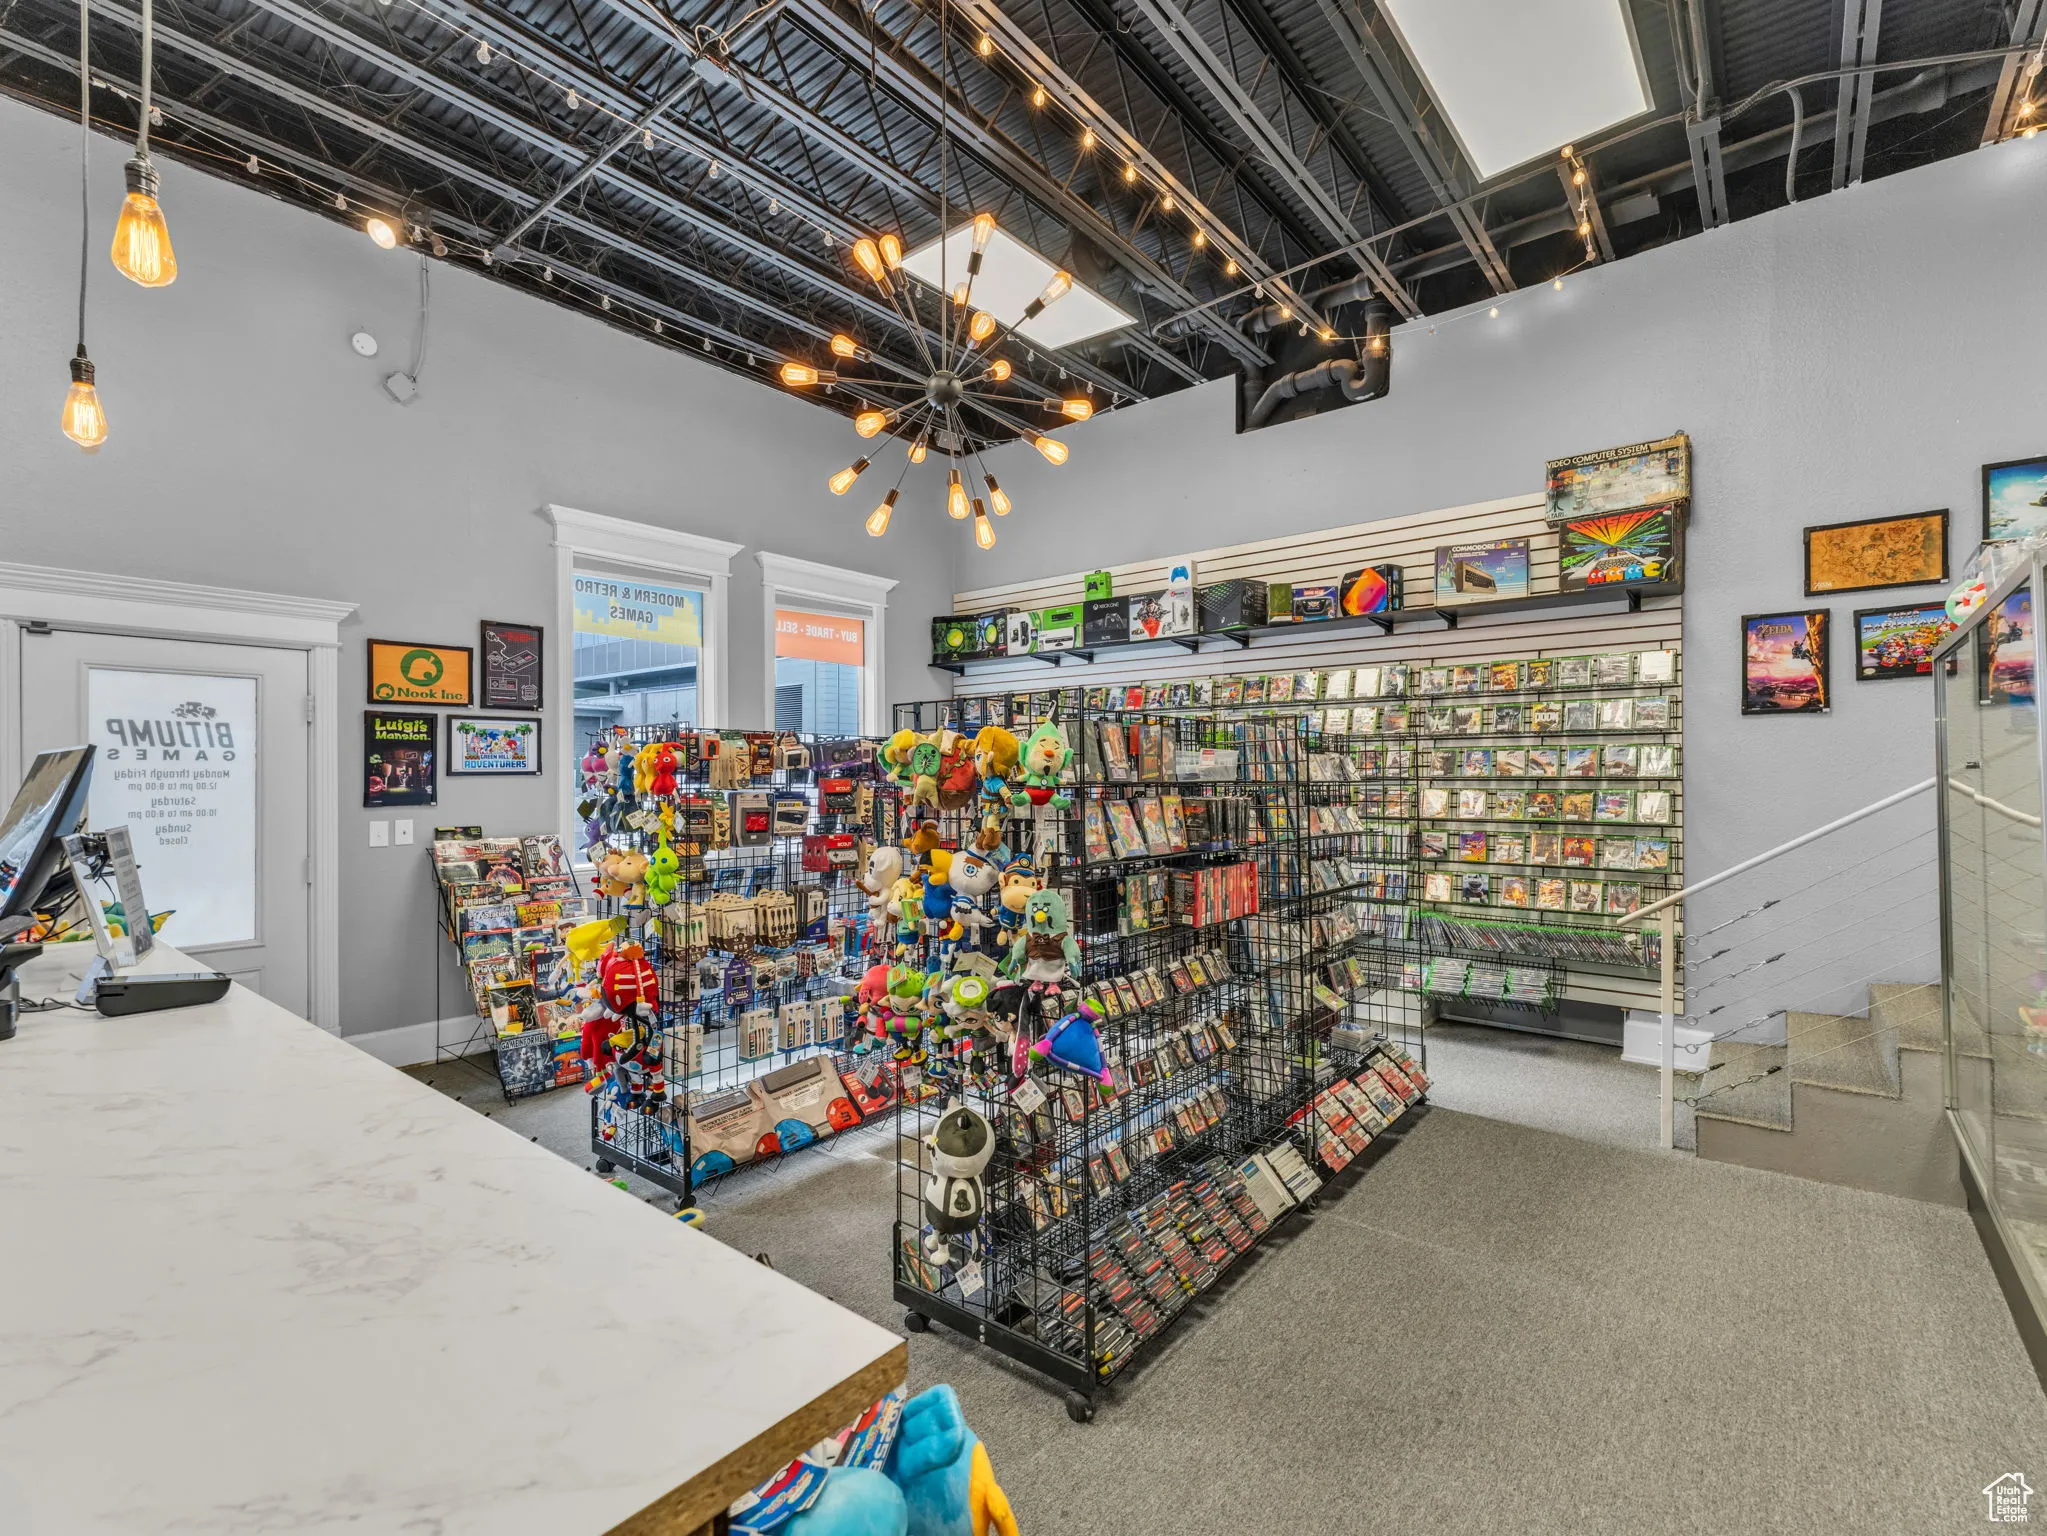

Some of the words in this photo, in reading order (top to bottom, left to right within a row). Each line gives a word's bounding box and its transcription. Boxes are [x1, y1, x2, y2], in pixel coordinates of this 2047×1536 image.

[1546, 457, 1571, 469] VIDEO
[1572, 449, 1616, 464] COMPUTER
[1617, 444, 1649, 456] SYSTEM
[1451, 543, 1495, 552] COMMODORE
[1757, 624, 1793, 638] ZELDA
[397, 687, 437, 699] Nook
[441, 688, 466, 701] Inc.
[375, 718, 428, 733] Luigi's
[464, 760, 527, 769] ADVENTURERS
[526, 904, 556, 912] TOMB
[468, 910, 510, 920] PlayStation
[522, 912, 559, 922] RAIDER
